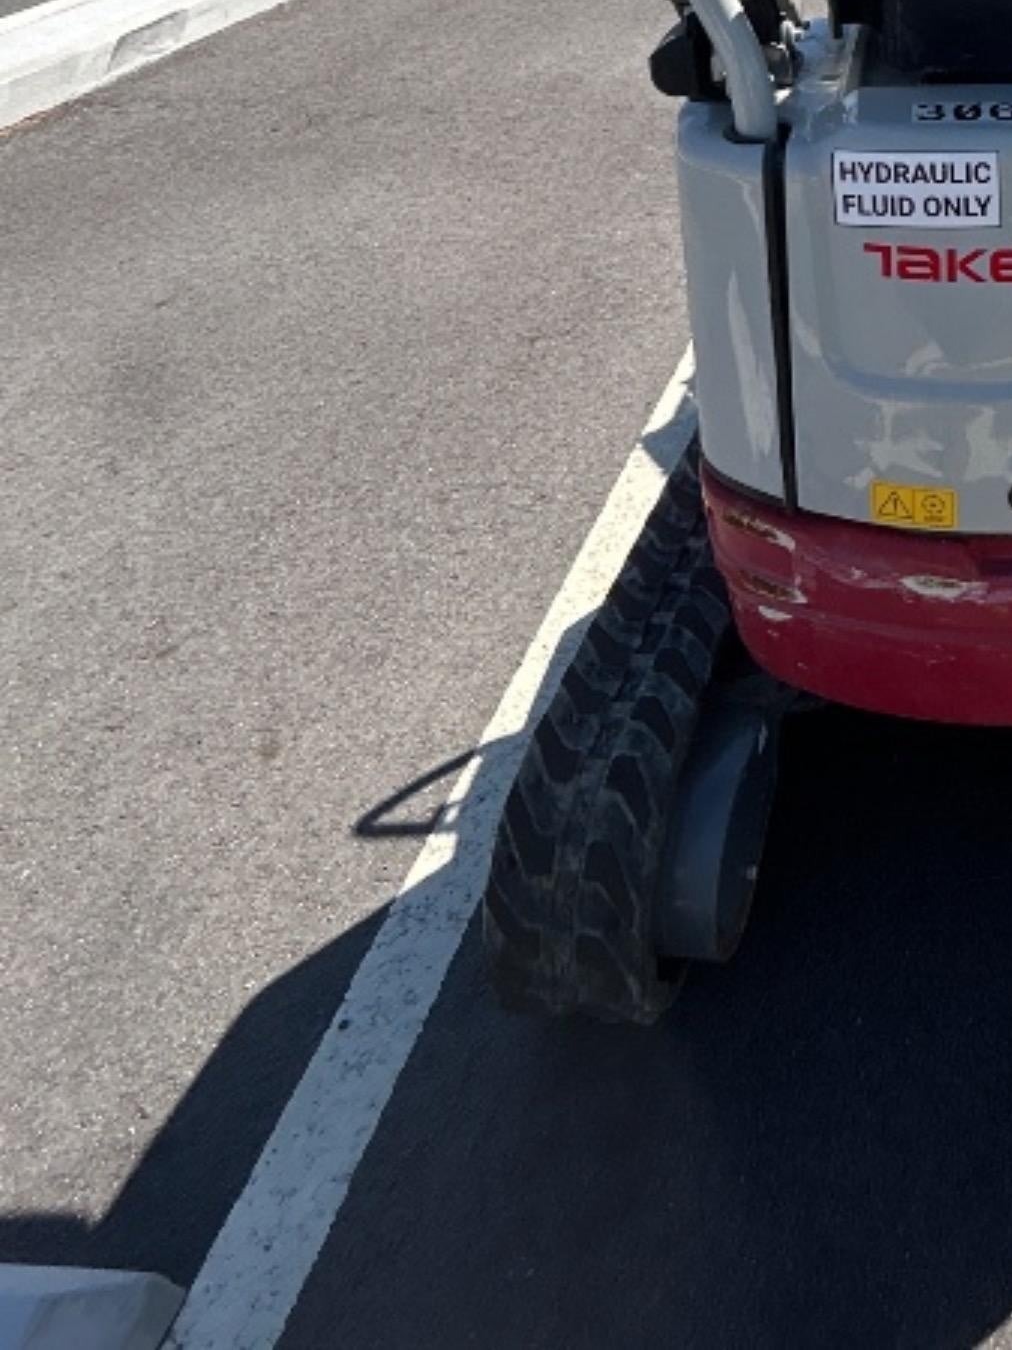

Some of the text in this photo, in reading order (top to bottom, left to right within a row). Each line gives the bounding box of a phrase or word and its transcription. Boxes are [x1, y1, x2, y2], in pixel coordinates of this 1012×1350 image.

[839, 162, 991, 184] HYDRAULIC
[842, 194, 991, 217] FLUID ONLY
